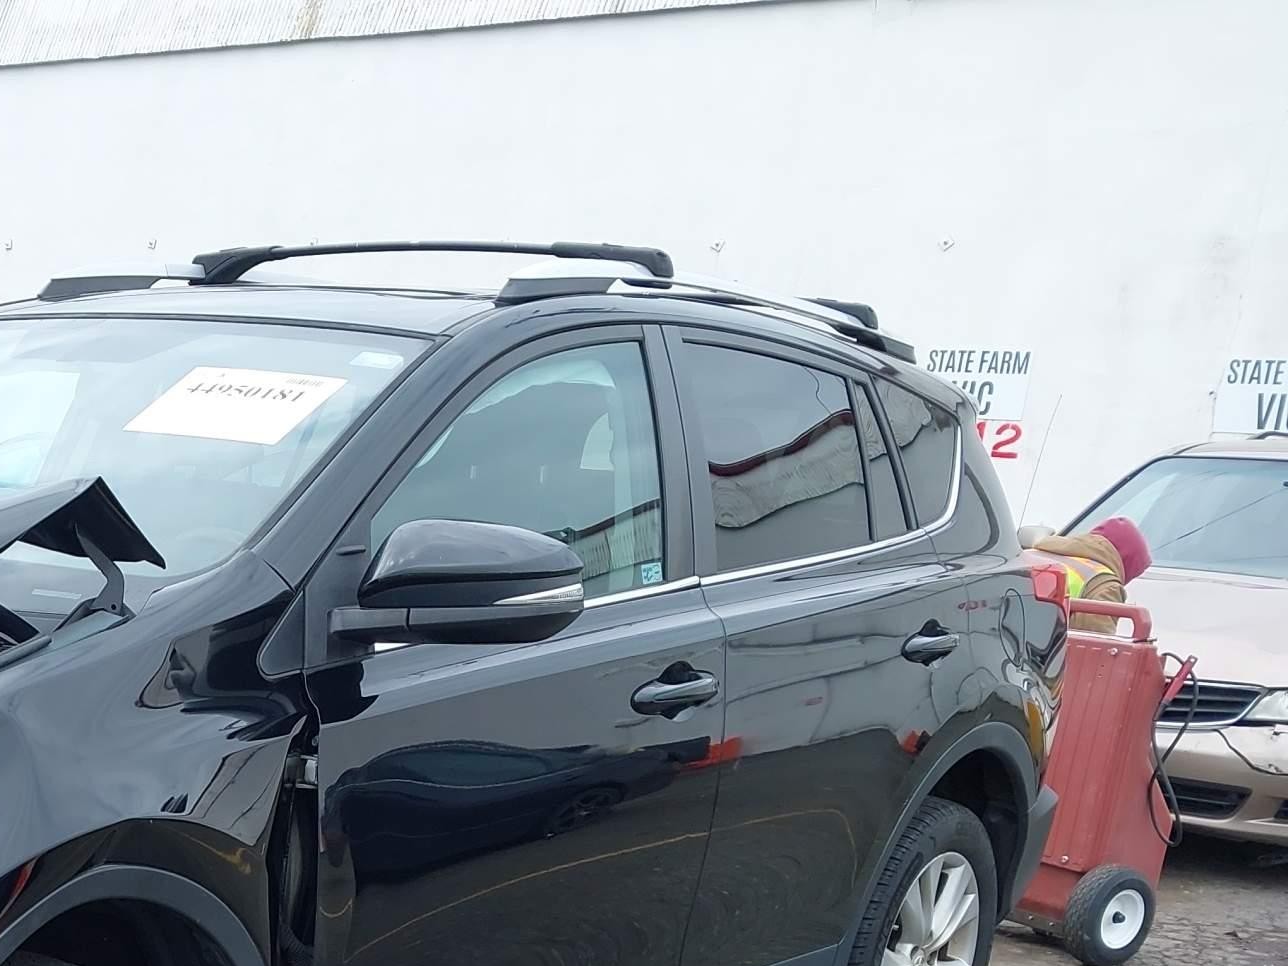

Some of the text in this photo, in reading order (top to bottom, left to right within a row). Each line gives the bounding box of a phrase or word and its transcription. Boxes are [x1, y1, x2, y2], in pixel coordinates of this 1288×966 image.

[927, 350, 1031, 375] STATE FARM
[1227, 359, 1287, 385] STATE
[1256, 393, 1288, 431] VI
